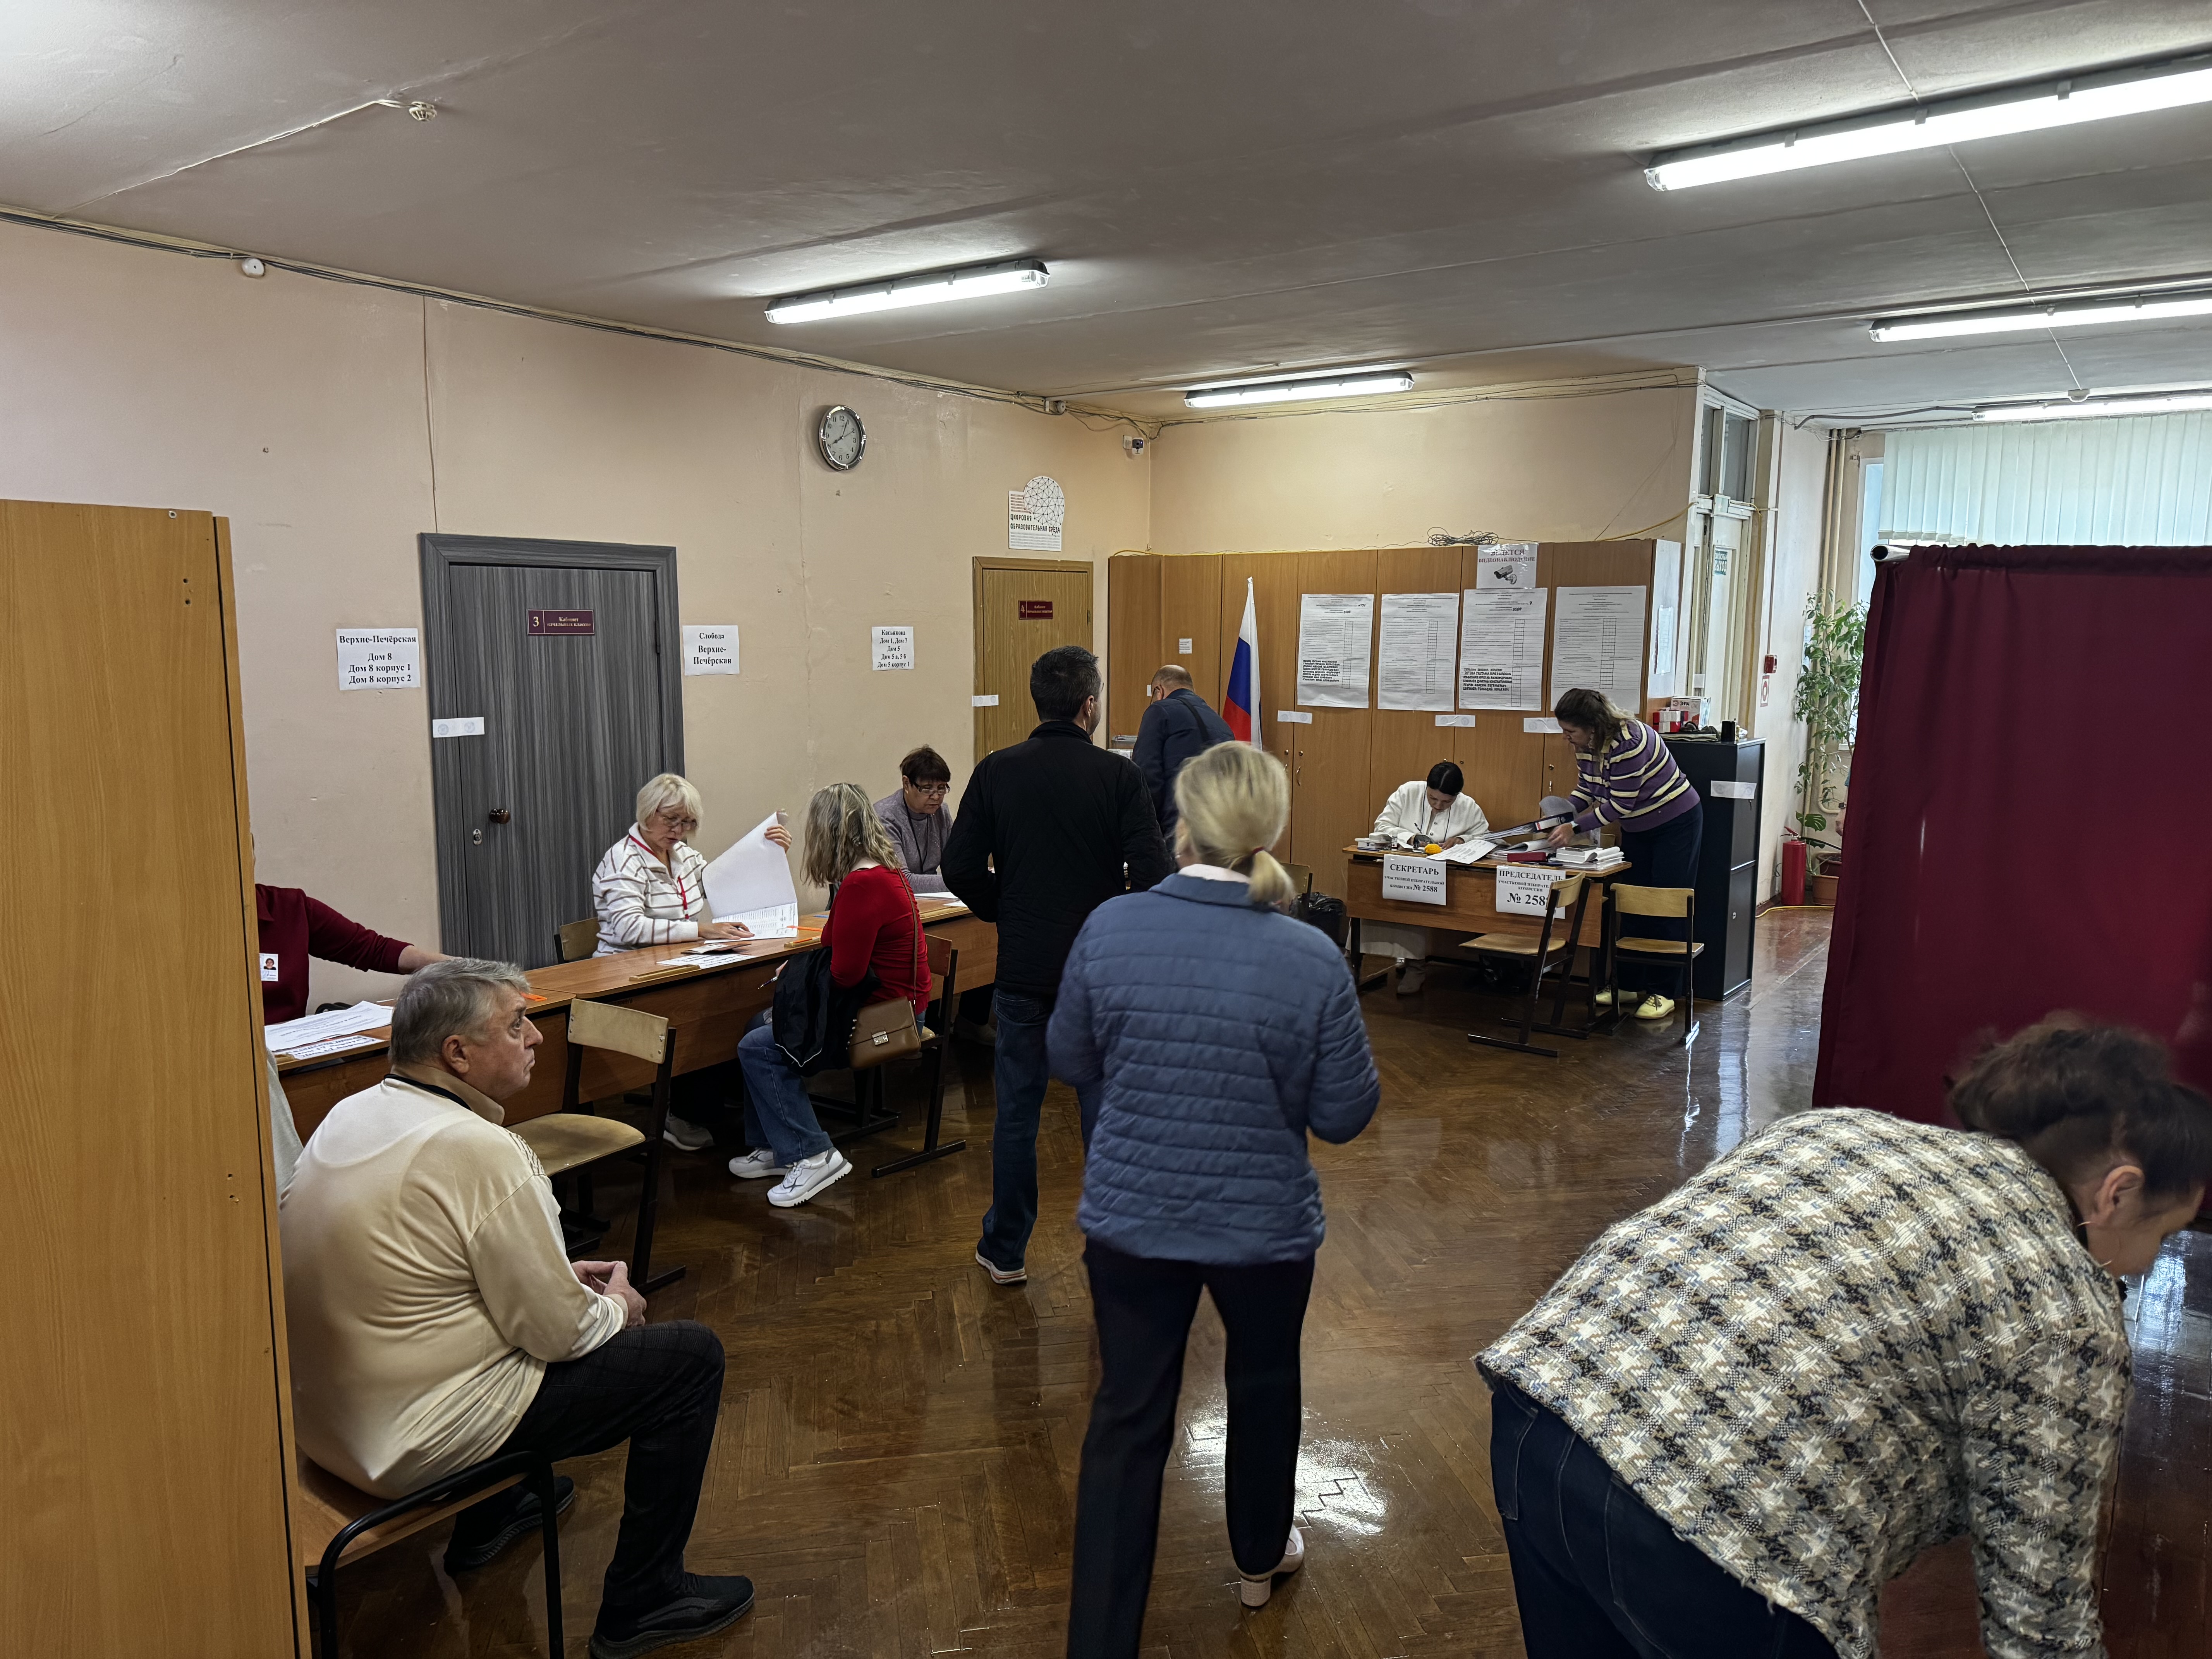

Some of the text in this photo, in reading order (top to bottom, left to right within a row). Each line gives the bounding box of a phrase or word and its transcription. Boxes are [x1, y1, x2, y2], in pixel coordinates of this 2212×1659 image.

[1010, 523, 1048, 531] ОБРАЗОВАТЕЛЬНАЯ
[533, 617, 539, 627] 3
[340, 635, 416, 645] Верхне-Печёрская
[698, 645, 726, 654] Верхне-
[368, 653, 385, 662] Дом
[694, 657, 731, 666] Печёрская
[349, 665, 366, 673] Дом
[376, 665, 405, 673] корпус
[349, 676, 367, 685] Дом
[376, 676, 405, 684] корпус
[1390, 864, 1439, 875] СЕКРЕТАРЬ
[1499, 870, 1563, 881] ПРЕДСЕДАТЕЛЬ
[1507, 893, 1548, 906] № 258
